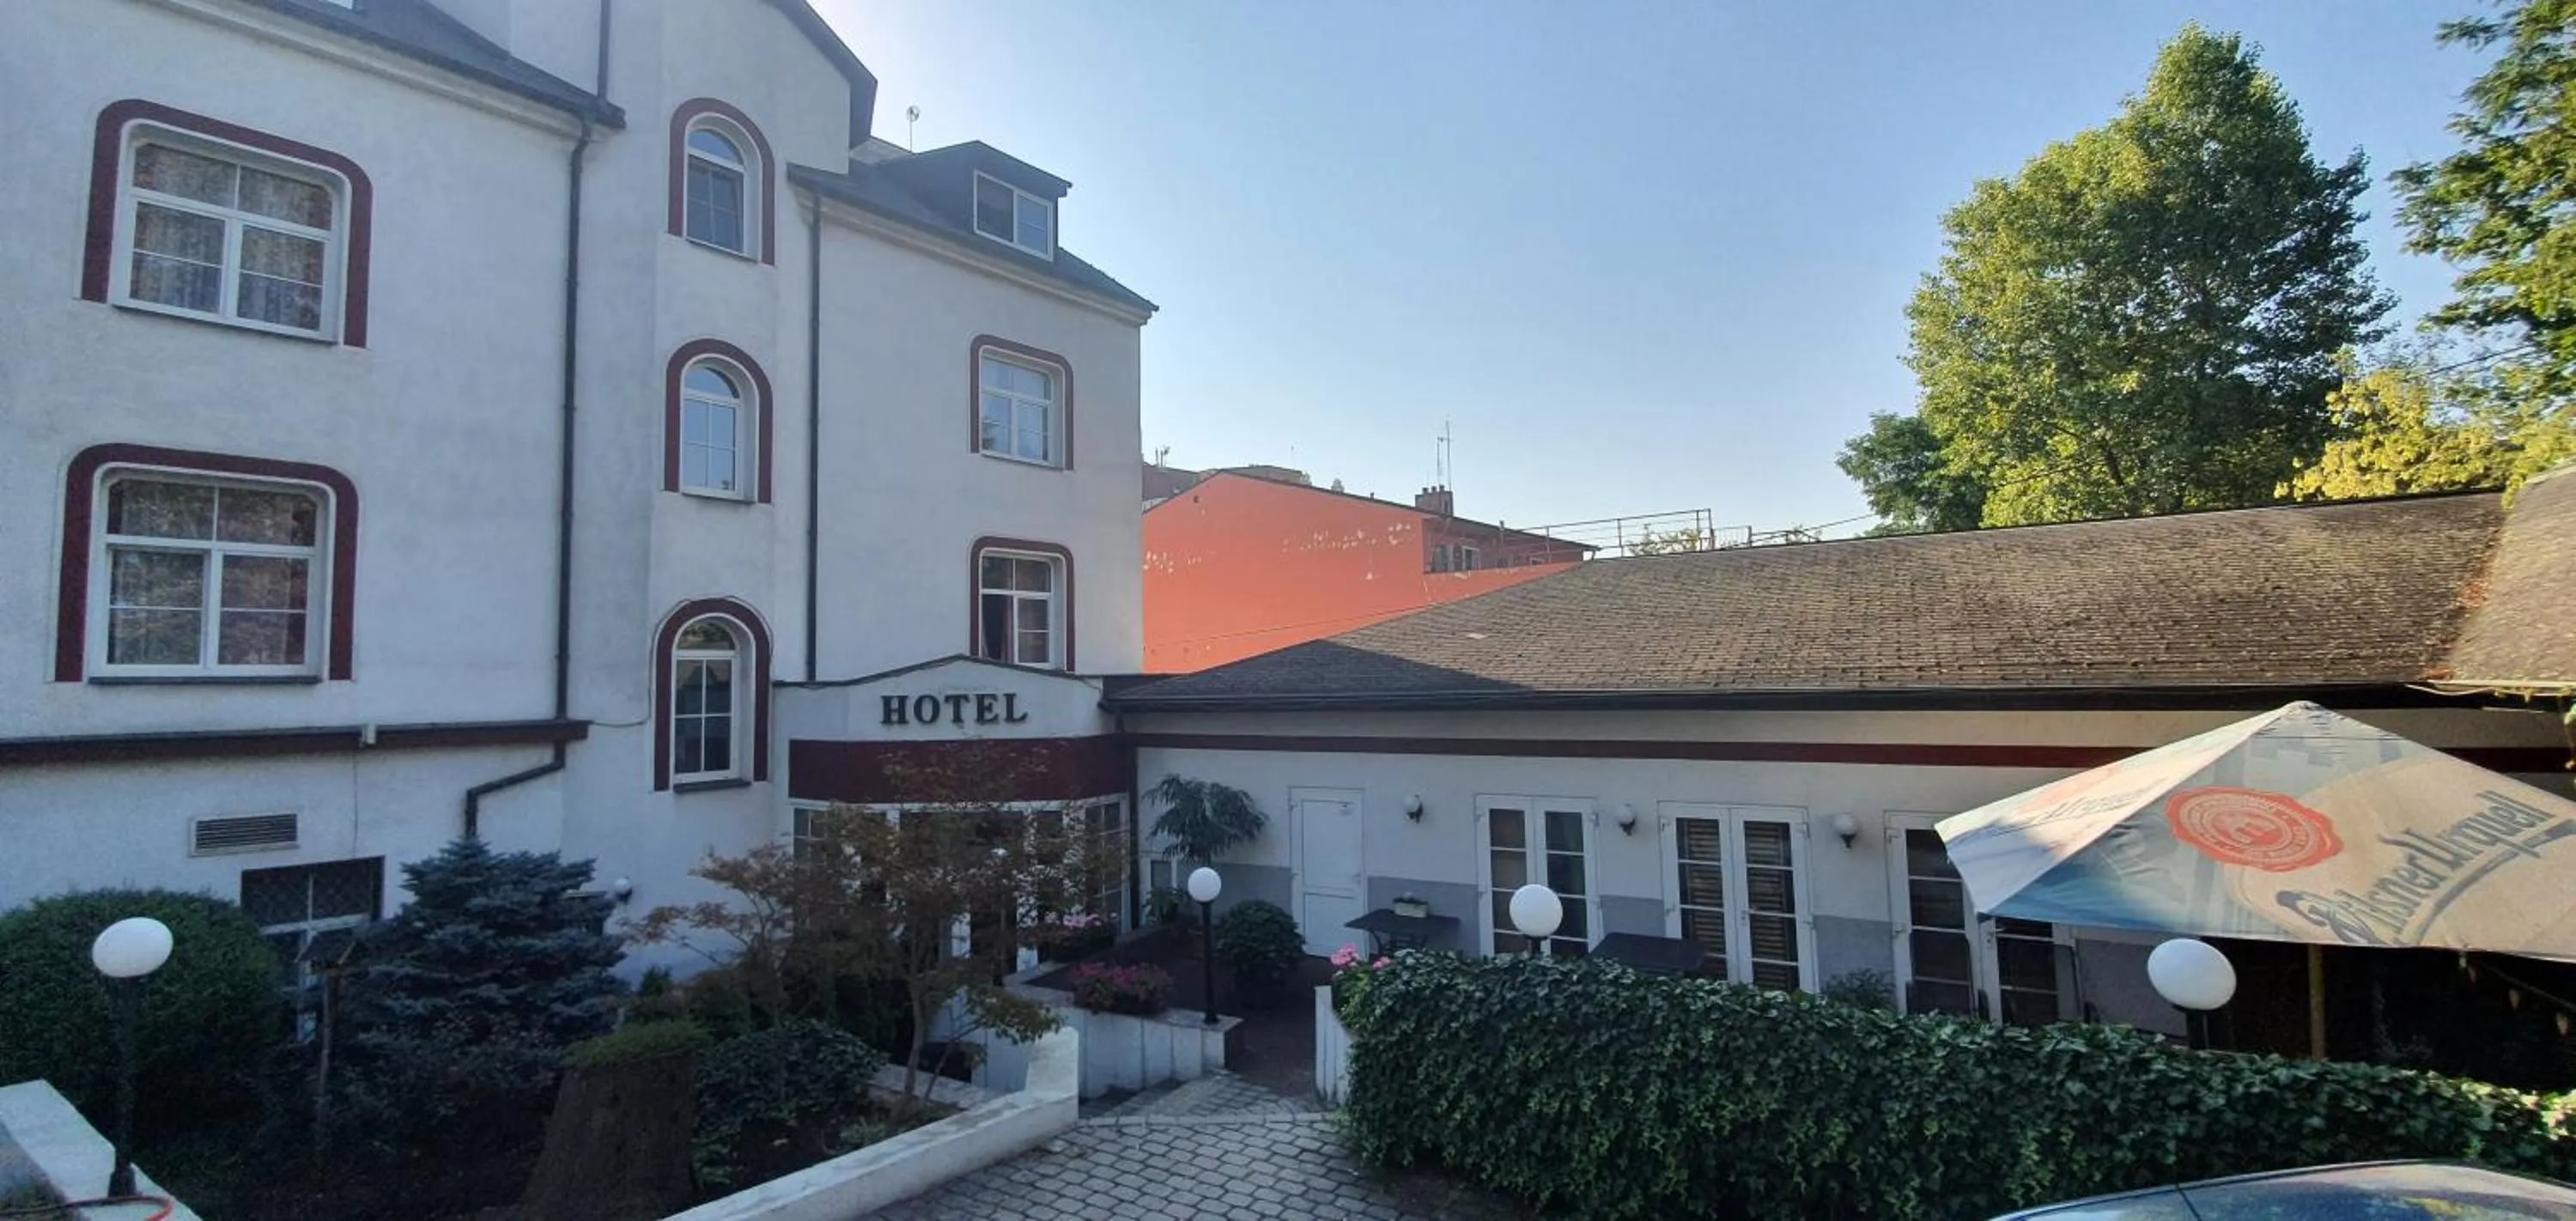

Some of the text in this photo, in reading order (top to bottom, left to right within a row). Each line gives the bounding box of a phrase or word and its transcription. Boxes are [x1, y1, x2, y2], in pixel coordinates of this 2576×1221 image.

[880, 693, 1029, 725] HOTEL
[2275, 853, 2447, 945] Pilsner
[2377, 790, 2556, 872] Urquell
